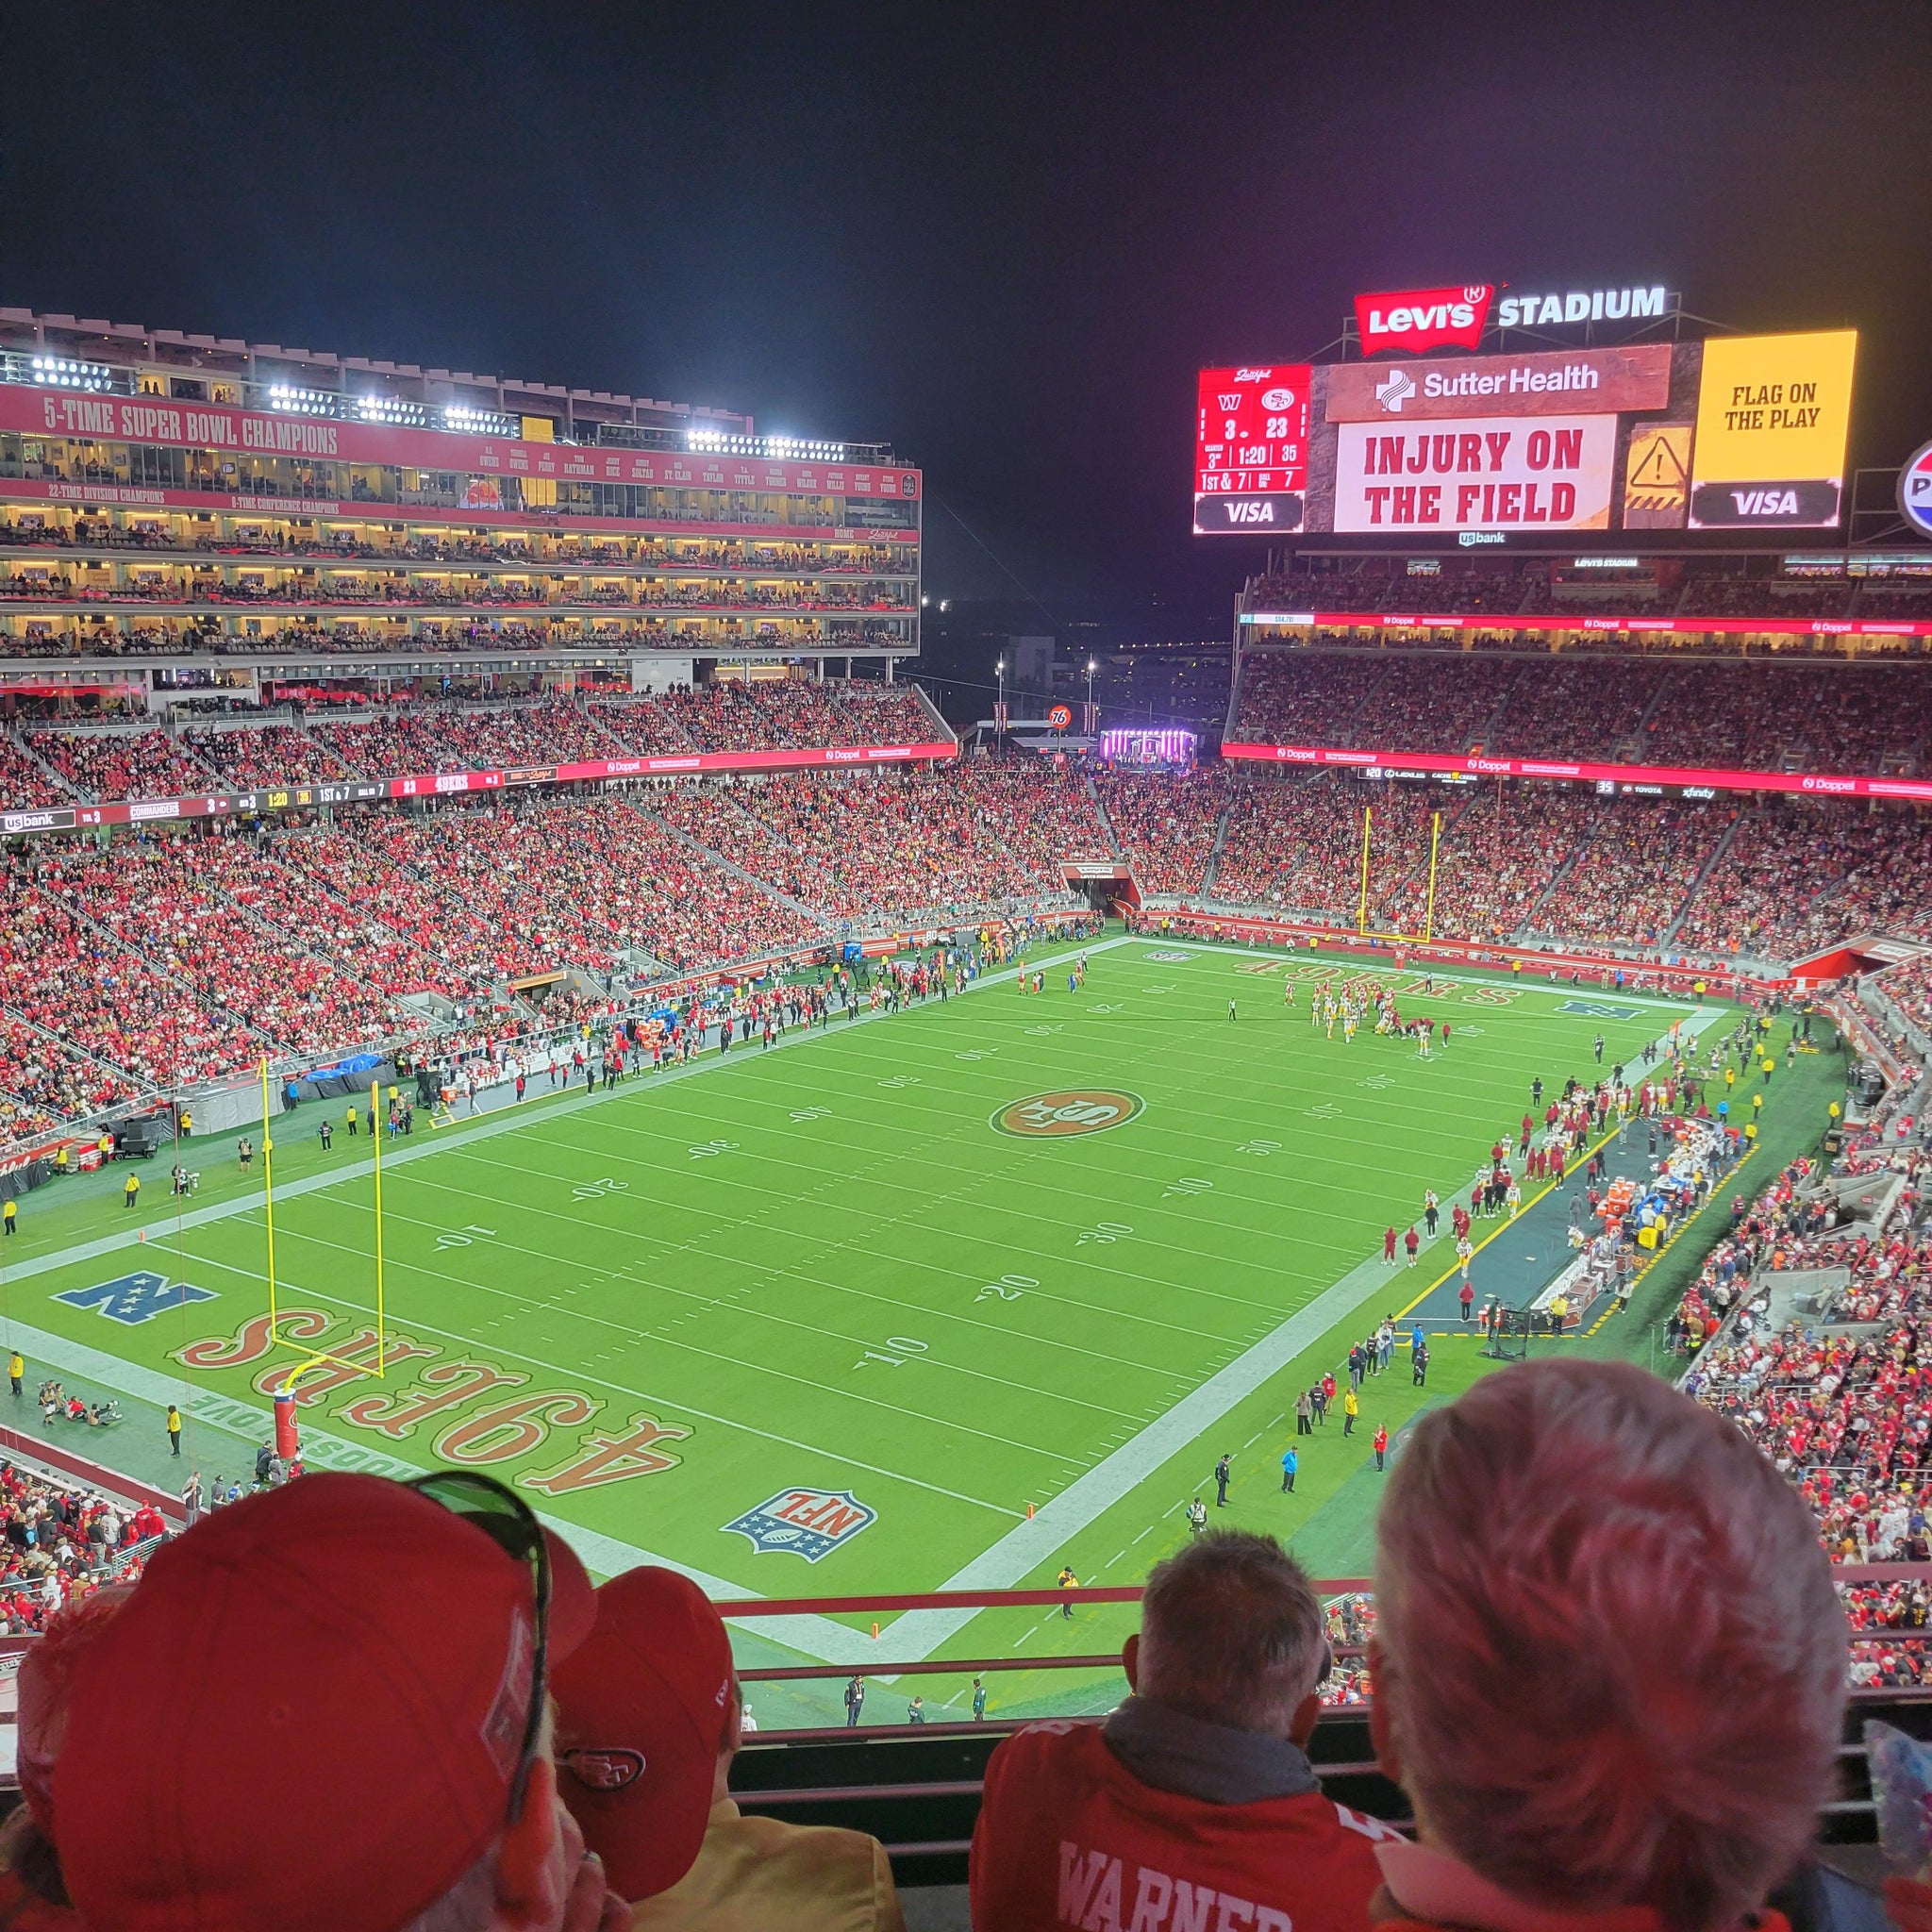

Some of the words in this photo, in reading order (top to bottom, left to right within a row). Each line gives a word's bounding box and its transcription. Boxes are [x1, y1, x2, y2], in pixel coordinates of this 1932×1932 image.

[1499, 287, 1665, 327] STADIUM
[1424, 372, 1506, 398] Sutter
[1509, 365, 1597, 392] Health
[1732, 385, 1783, 407] FLAG
[1790, 383, 1817, 404] ON
[43, 397, 114, 433] 5-TIME
[121, 406, 181, 440] SUPER
[186, 412, 237, 445] BOWL
[242, 418, 338, 455] CHAMPIONS
[1266, 417, 1288, 438] 23
[1724, 409, 1763, 431] THE
[1770, 408, 1821, 429] PLAY
[1224, 419, 1236, 441] 3
[1239, 446, 1266, 464] 1:20
[1282, 445, 1297, 461] 35
[1364, 432, 1510, 475] INJURY
[1526, 429, 1583, 471] ON
[1202, 474, 1219, 491] 1ST
[1221, 473, 1231, 490] &
[1239, 473, 1246, 490] 7
[1285, 471, 1293, 487] 7
[49, 484, 82, 499] 22-TIME
[84, 488, 118, 501] DIVISION
[121, 489, 164, 504] CHAMPIONS
[258, 498, 301, 512] CONFERENCE
[303, 501, 340, 514] CHAMPIONS
[1365, 486, 1441, 524] THE
[1457, 482, 1576, 524] FIELD
[1730, 491, 1798, 515] VISA
[1224, 503, 1274, 523] VISA
[835, 529, 854, 539] HOME
[1391, 616, 1414, 625] Doppel
[1593, 620, 1619, 629] Doppel
[1823, 623, 1852, 632] Doppel
[1052, 711, 1067, 724] 76
[835, 749, 859, 760] Doppel
[1287, 749, 1315, 759] Doppel
[615, 761, 641, 773] Doppel
[1478, 760, 1510, 772] Doppel
[378, 784, 384, 796] 7
[404, 781, 416, 793] 23
[435, 775, 468, 791] 49ERS
[1598, 782, 1611, 792] 35
[1635, 786, 1662, 794] TOYOTA
[1816, 779, 1856, 791] Doppel
[268, 791, 288, 807] 1:20
[320, 788, 334, 802] 1ST
[336, 791, 341, 800] &
[343, 787, 350, 800] 7
[1682, 787, 1715, 799] xfinity
[208, 799, 215, 812] 3
[249, 795, 257, 808] 3
[94, 810, 101, 824] 3
[130, 804, 180, 818] COMMANDERS
[877, 1075, 922, 1089] 50
[793, 1105, 834, 1121] 40
[1303, 1106, 1343, 1120] 40
[694, 1140, 740, 1157] 30
[1238, 1139, 1283, 1157] 50
[578, 1177, 629, 1199] 20
[1167, 1177, 1213, 1196] 40
[447, 1224, 498, 1248] 10
[1080, 1222, 1134, 1244] 30
[982, 1274, 1041, 1302] 20
[865, 1336, 929, 1368] 10
[165, 1307, 695, 1498] 49ERS
[774, 1493, 865, 1537] NFL
